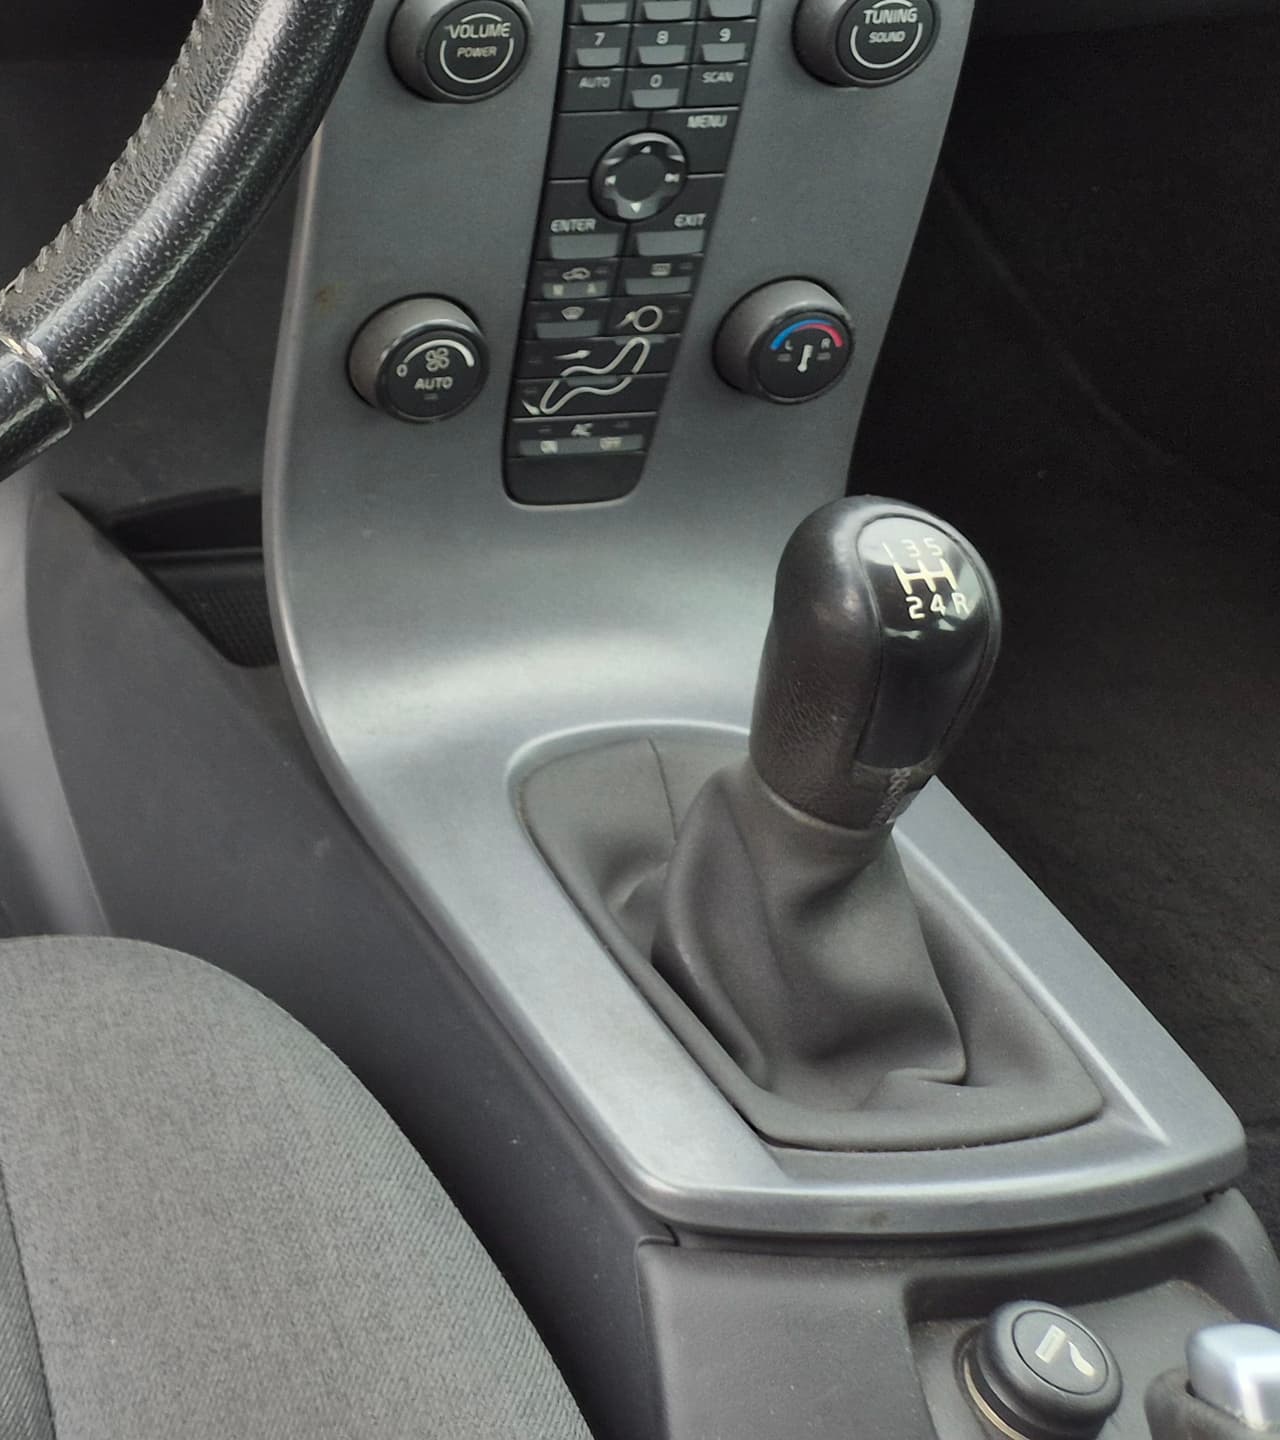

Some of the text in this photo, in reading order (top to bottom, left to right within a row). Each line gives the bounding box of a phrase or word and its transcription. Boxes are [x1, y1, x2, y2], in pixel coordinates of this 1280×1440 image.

[864, 8, 917, 24] TUNING
[448, 23, 511, 39] VOLUME
[656, 30, 669, 45] 8
[719, 28, 731, 42] 9
[869, 31, 906, 43] SOUND
[594, 32, 606, 46] 7
[457, 46, 497, 58] POWER
[579, 76, 610, 88] AUTO
[650, 74, 662, 88] 0
[702, 72, 734, 83] SCAN
[687, 115, 728, 128] MENU
[550, 218, 596, 232] ENTER
[674, 213, 707, 227] EXIT
[414, 376, 454, 390] AUTO
[901, 538, 920, 557] 3
[923, 537, 943, 556] 5
[905, 592, 971, 620] 2 4 R
